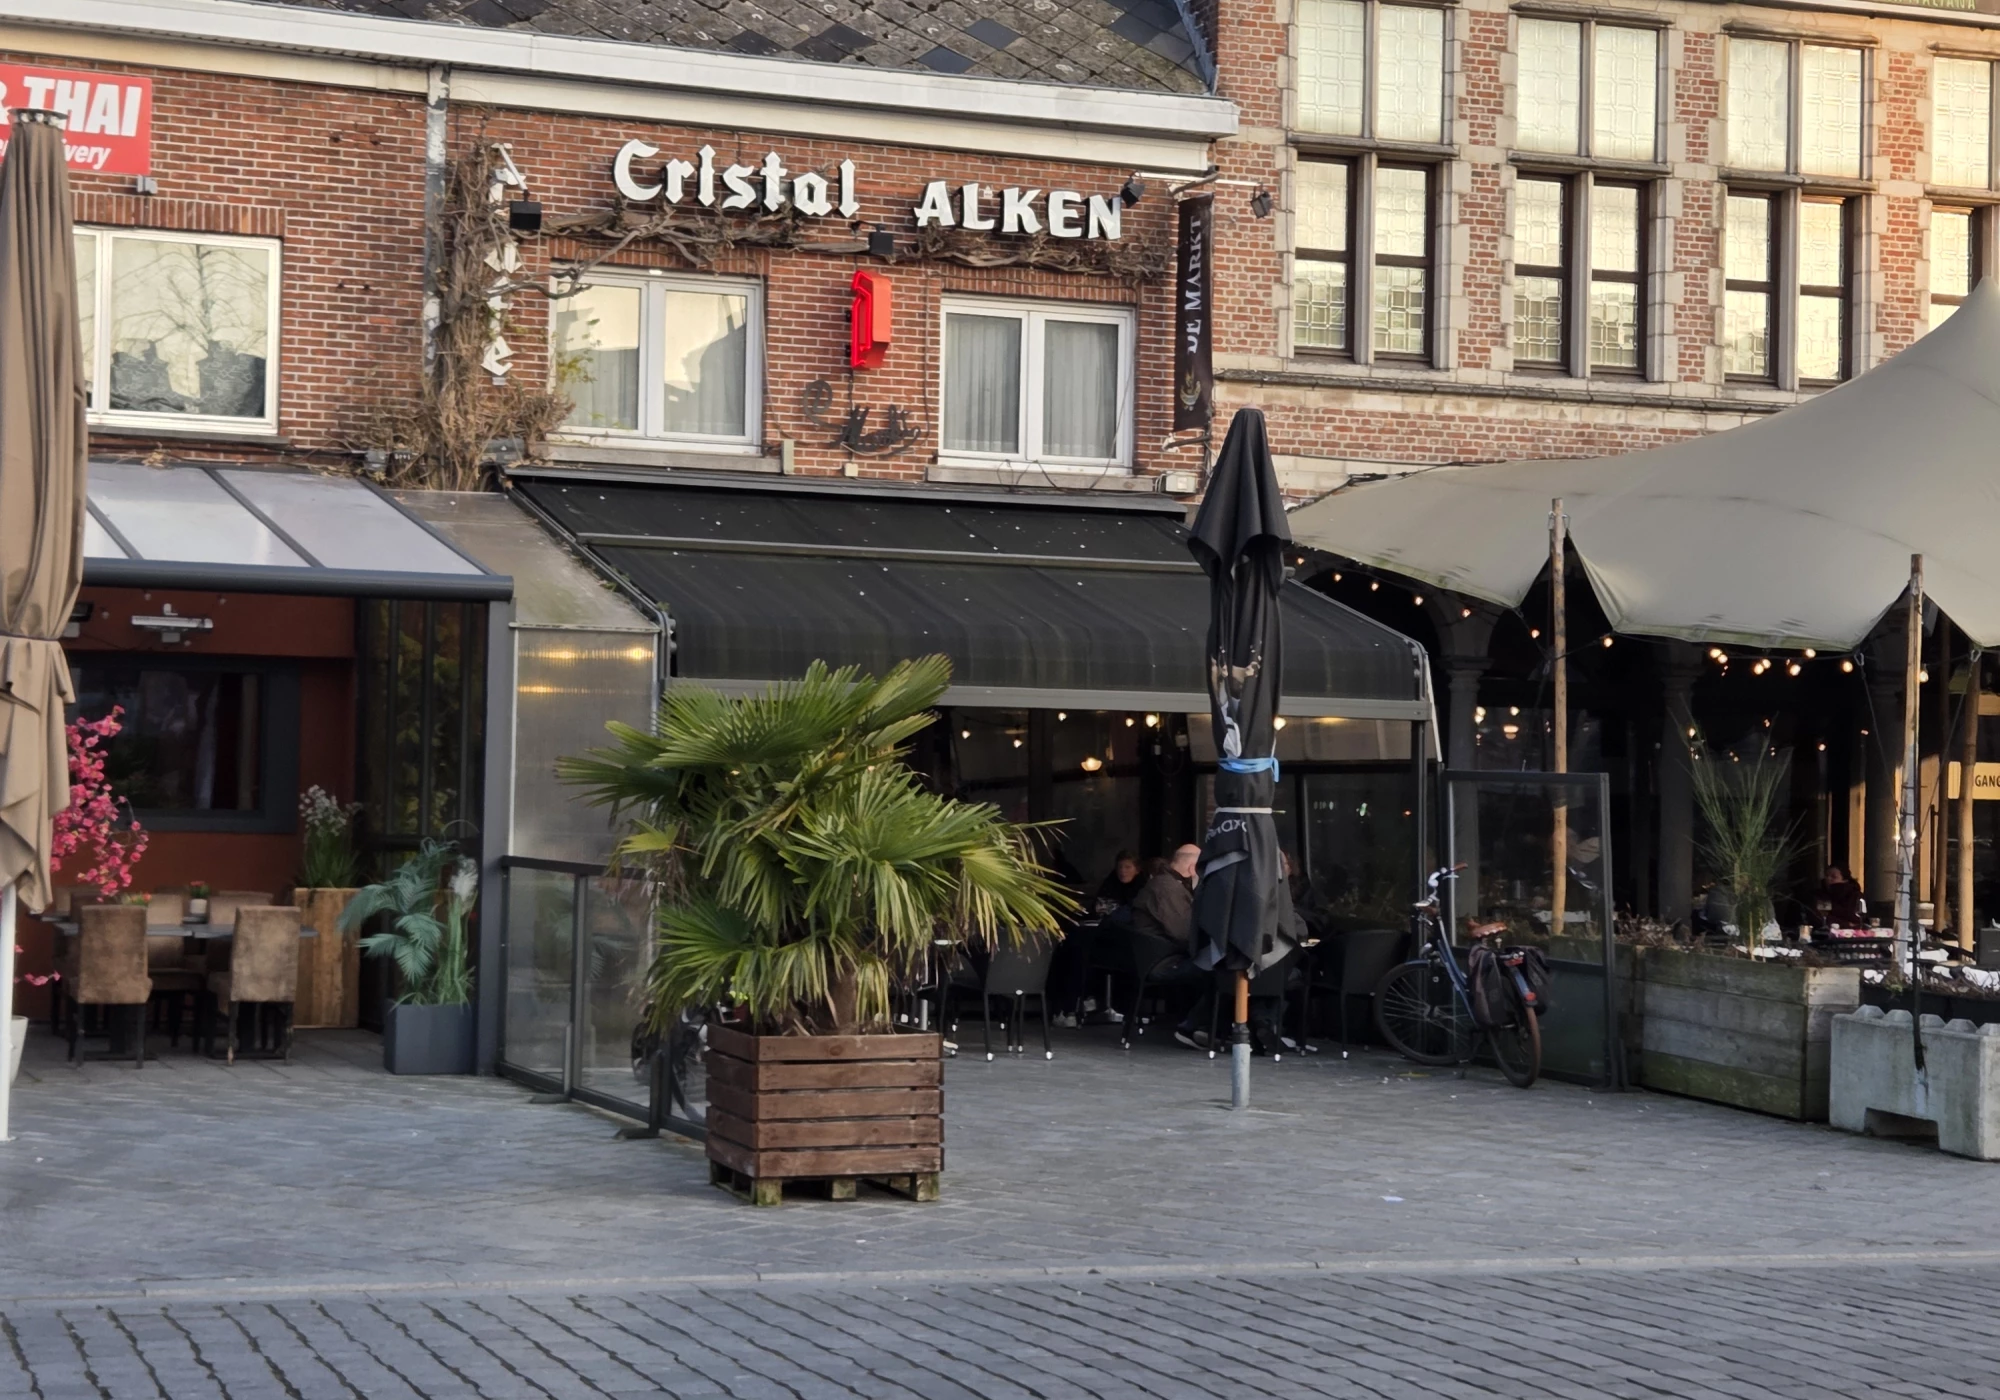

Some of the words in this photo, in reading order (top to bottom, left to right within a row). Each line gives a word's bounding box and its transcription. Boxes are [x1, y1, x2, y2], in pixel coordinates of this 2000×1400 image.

[23, 76, 142, 137] THAI
[613, 138, 860, 218] Cristal
[914, 180, 1121, 240] ALKEN
[1184, 215, 1202, 310] MARKT
